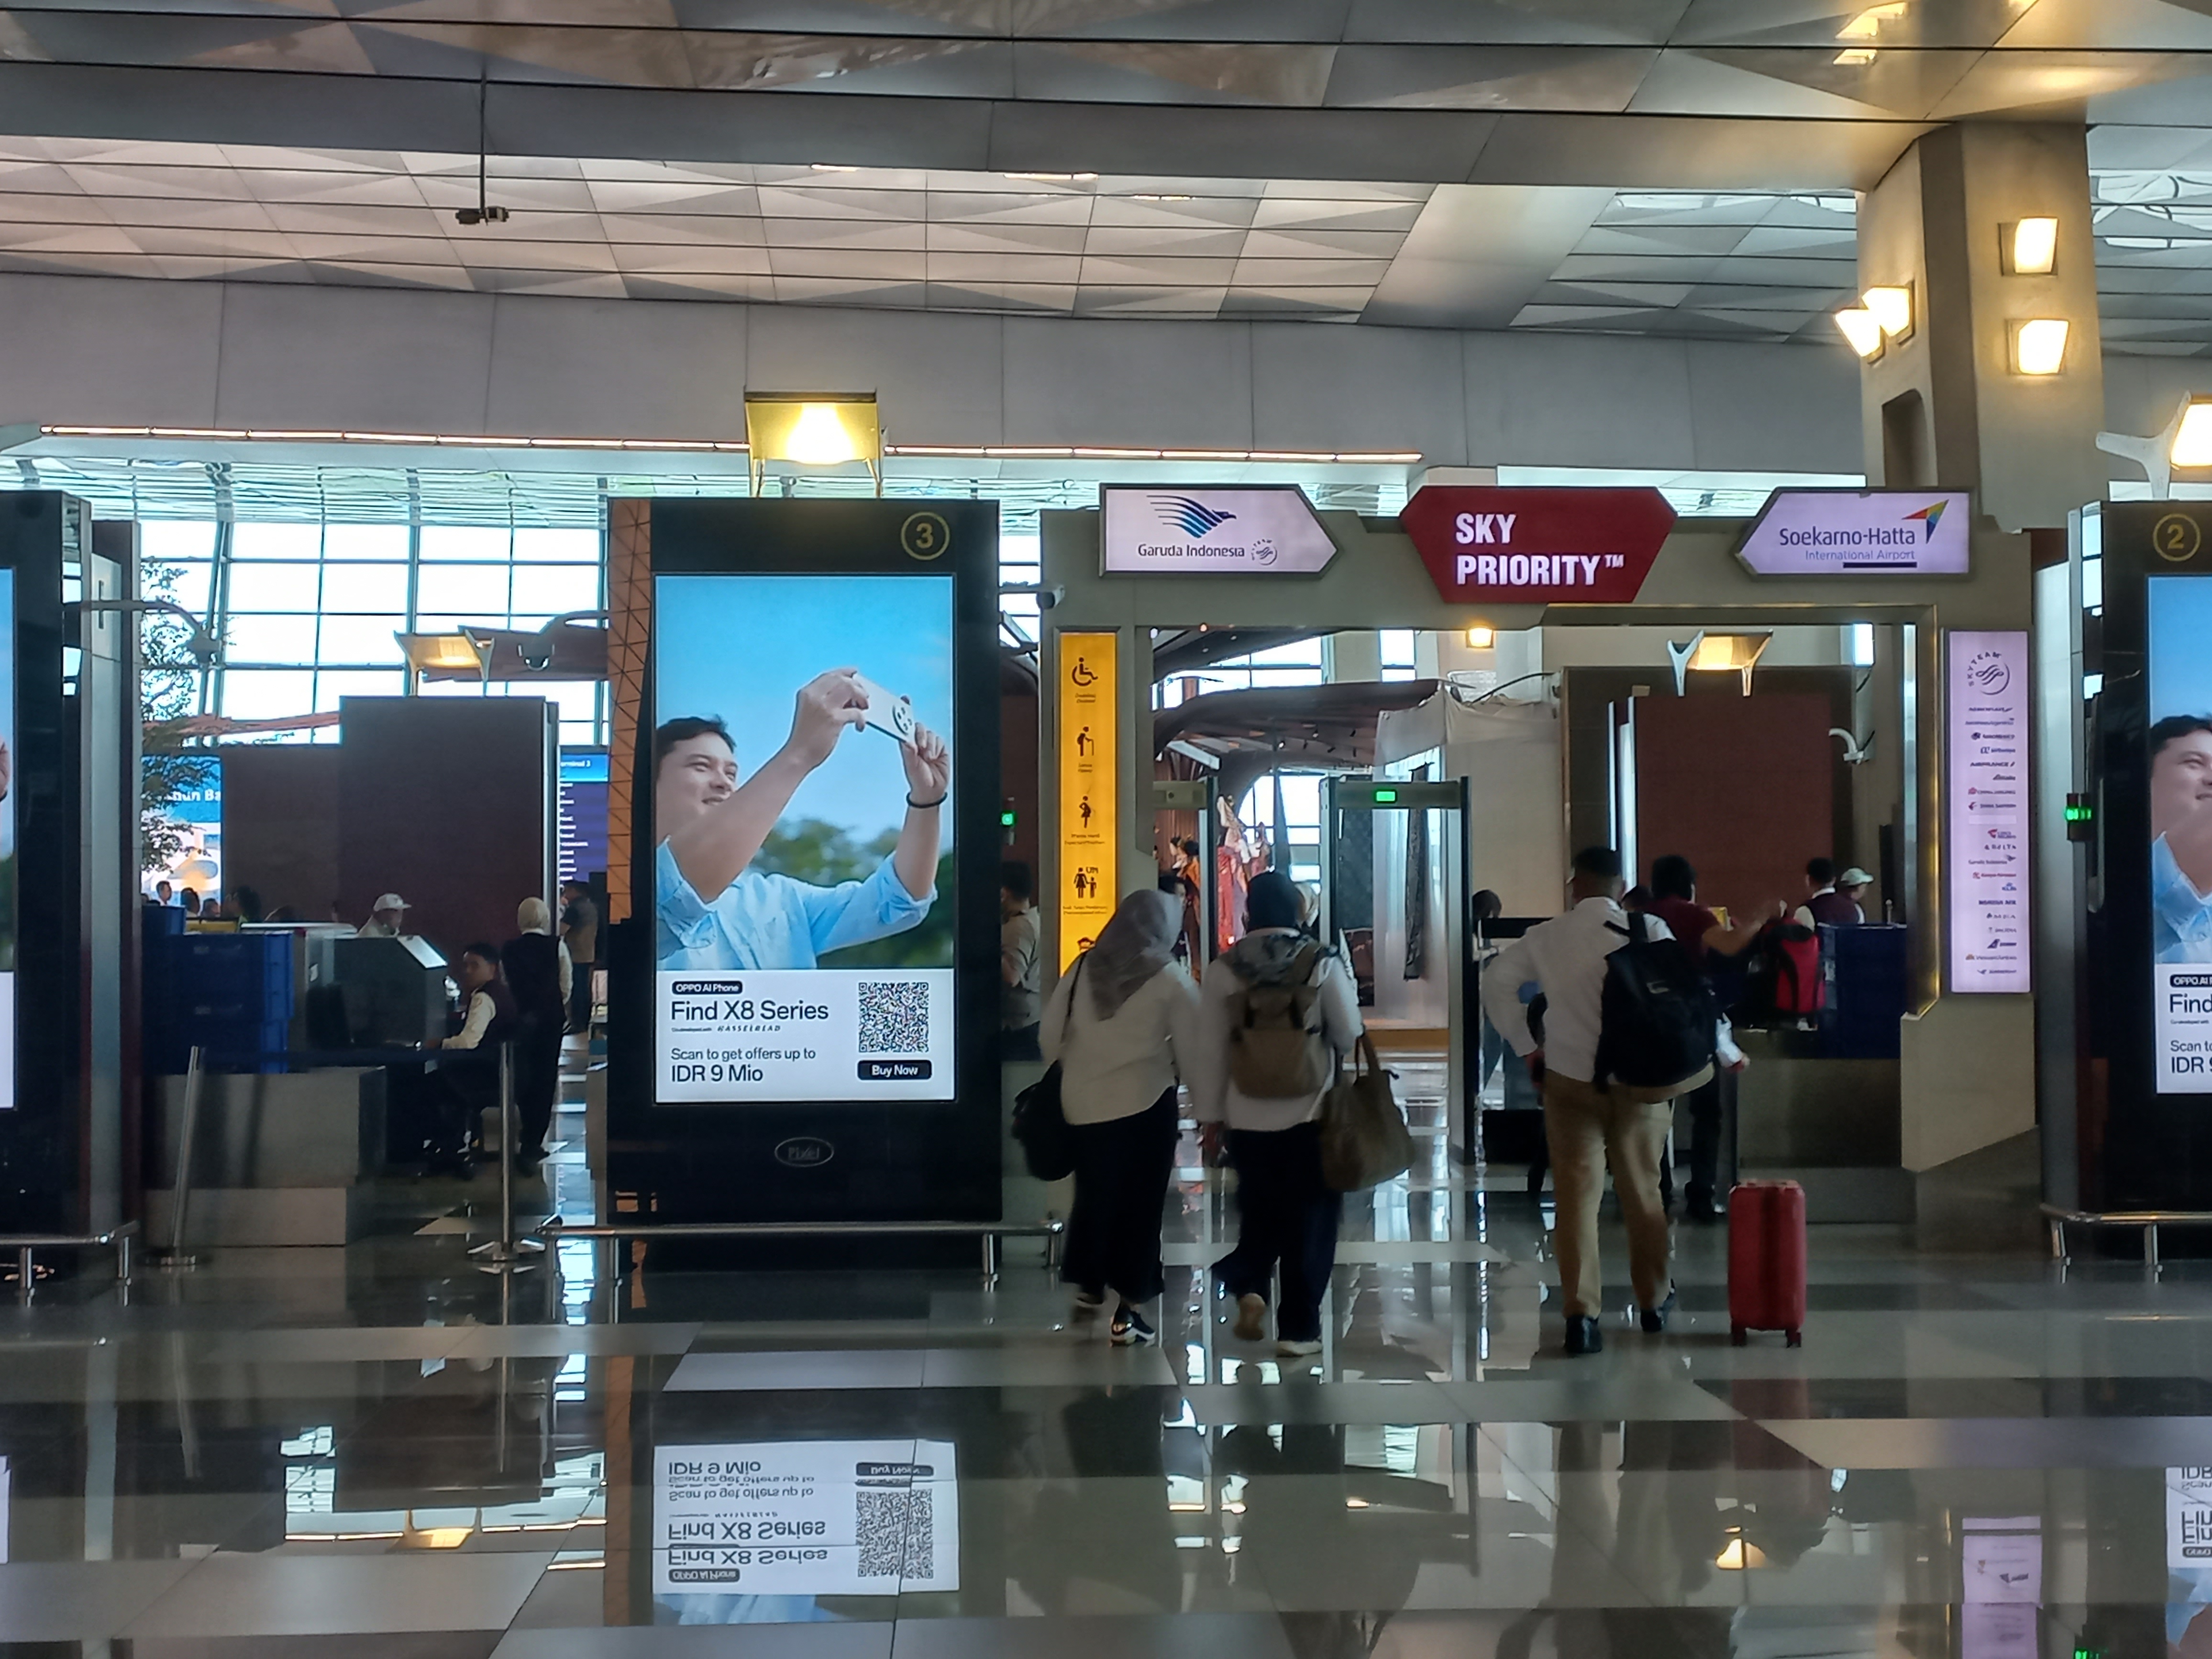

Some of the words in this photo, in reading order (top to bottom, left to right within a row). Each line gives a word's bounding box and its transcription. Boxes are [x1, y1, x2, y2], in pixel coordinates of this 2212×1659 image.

[916, 522, 933, 549] 3
[1456, 513, 1516, 544] SKY
[1780, 526, 1915, 546] Soekarno-Hatta
[2167, 524, 2184, 549] 2
[1138, 543, 1183, 557] Garuda
[1186, 544, 1245, 557] Indonesia
[1805, 550, 1873, 560] International
[1877, 550, 1914, 561] Airport
[675, 984, 702, 992] OPPO
[702, 984, 712, 992] AI
[713, 984, 739, 992] Phone
[2173, 977, 2199, 985] OPPO
[671, 1000, 718, 1020] Find
[723, 1000, 755, 1020] X8
[760, 1000, 829, 1020] Series
[2170, 1040, 2202, 1052] Scan
[671, 1048, 704, 1060] Scan
[707, 1048, 719, 1060] to
[721, 1048, 742, 1062] get
[745, 1047, 782, 1060] offers
[784, 1050, 801, 1062] up
[803, 1047, 816, 1059] to
[871, 1065, 893, 1077] Buy
[894, 1064, 918, 1076] Now
[2172, 1056, 2204, 1073] IDR
[672, 1065, 706, 1083] IDR
[711, 1064, 723, 1082] 9
[728, 1063, 764, 1082] Mio
